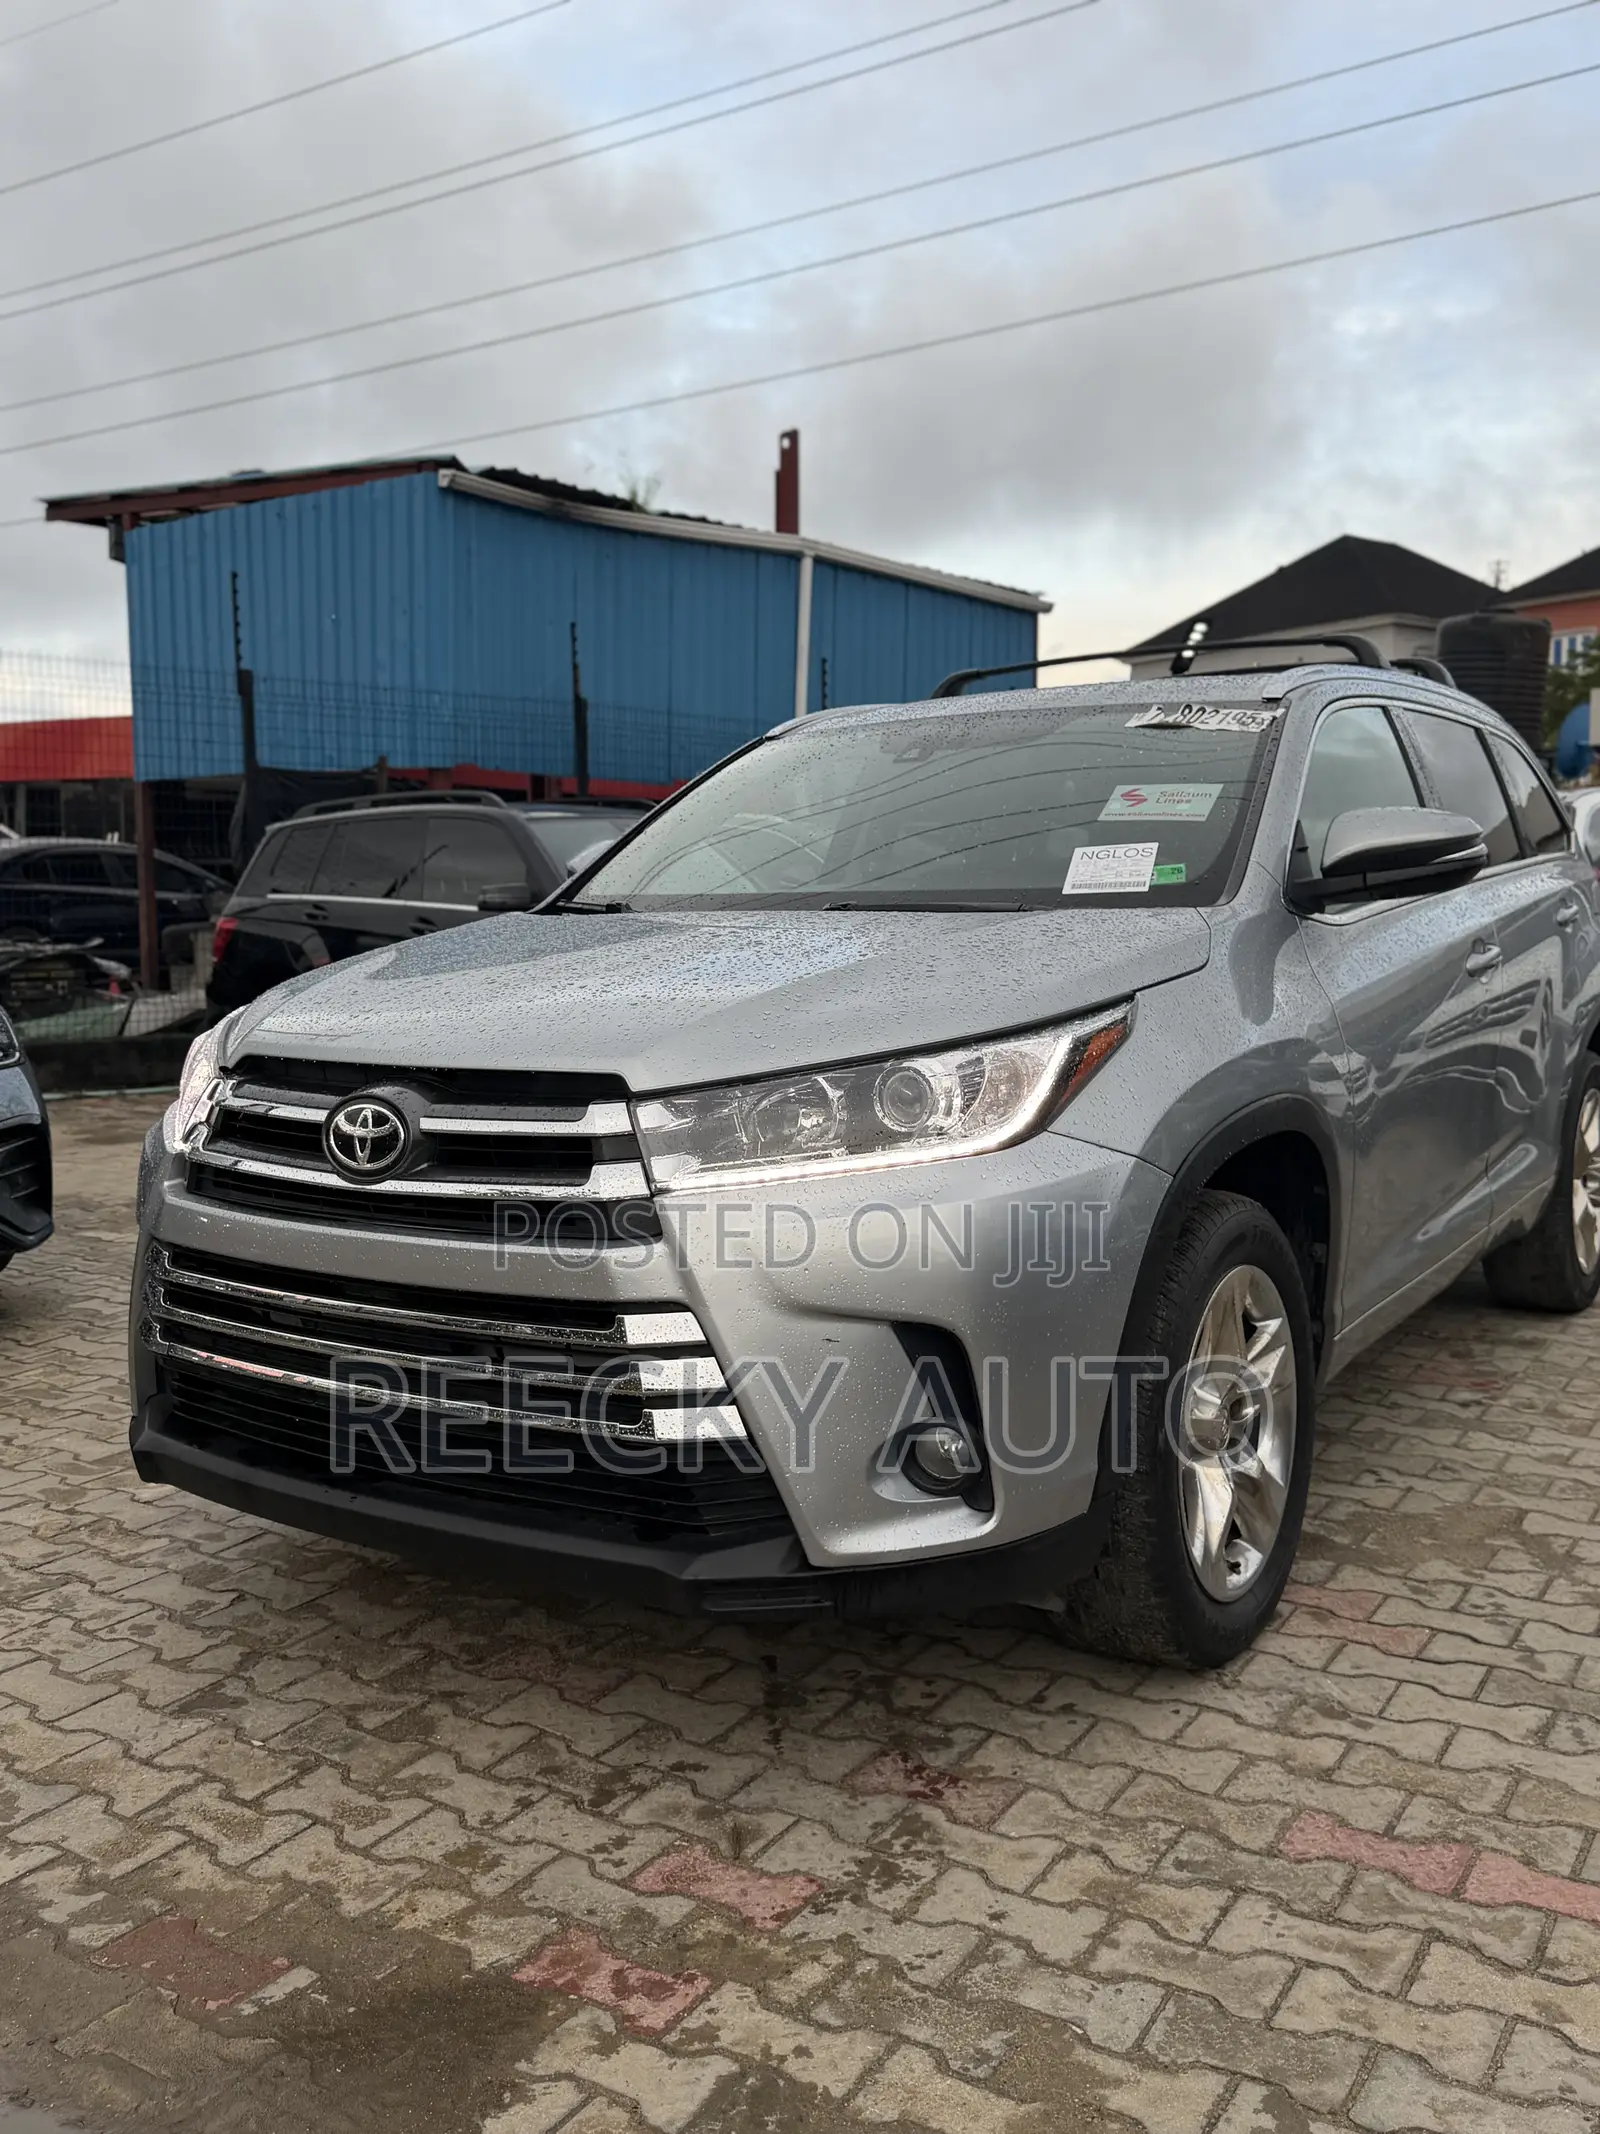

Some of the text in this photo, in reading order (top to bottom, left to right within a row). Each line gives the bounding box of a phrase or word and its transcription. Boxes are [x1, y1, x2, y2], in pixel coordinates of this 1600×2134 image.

[1158, 790, 1213, 799] Sallaum
[1155, 797, 1193, 805] Lines
[1079, 847, 1155, 861] NGLOS
